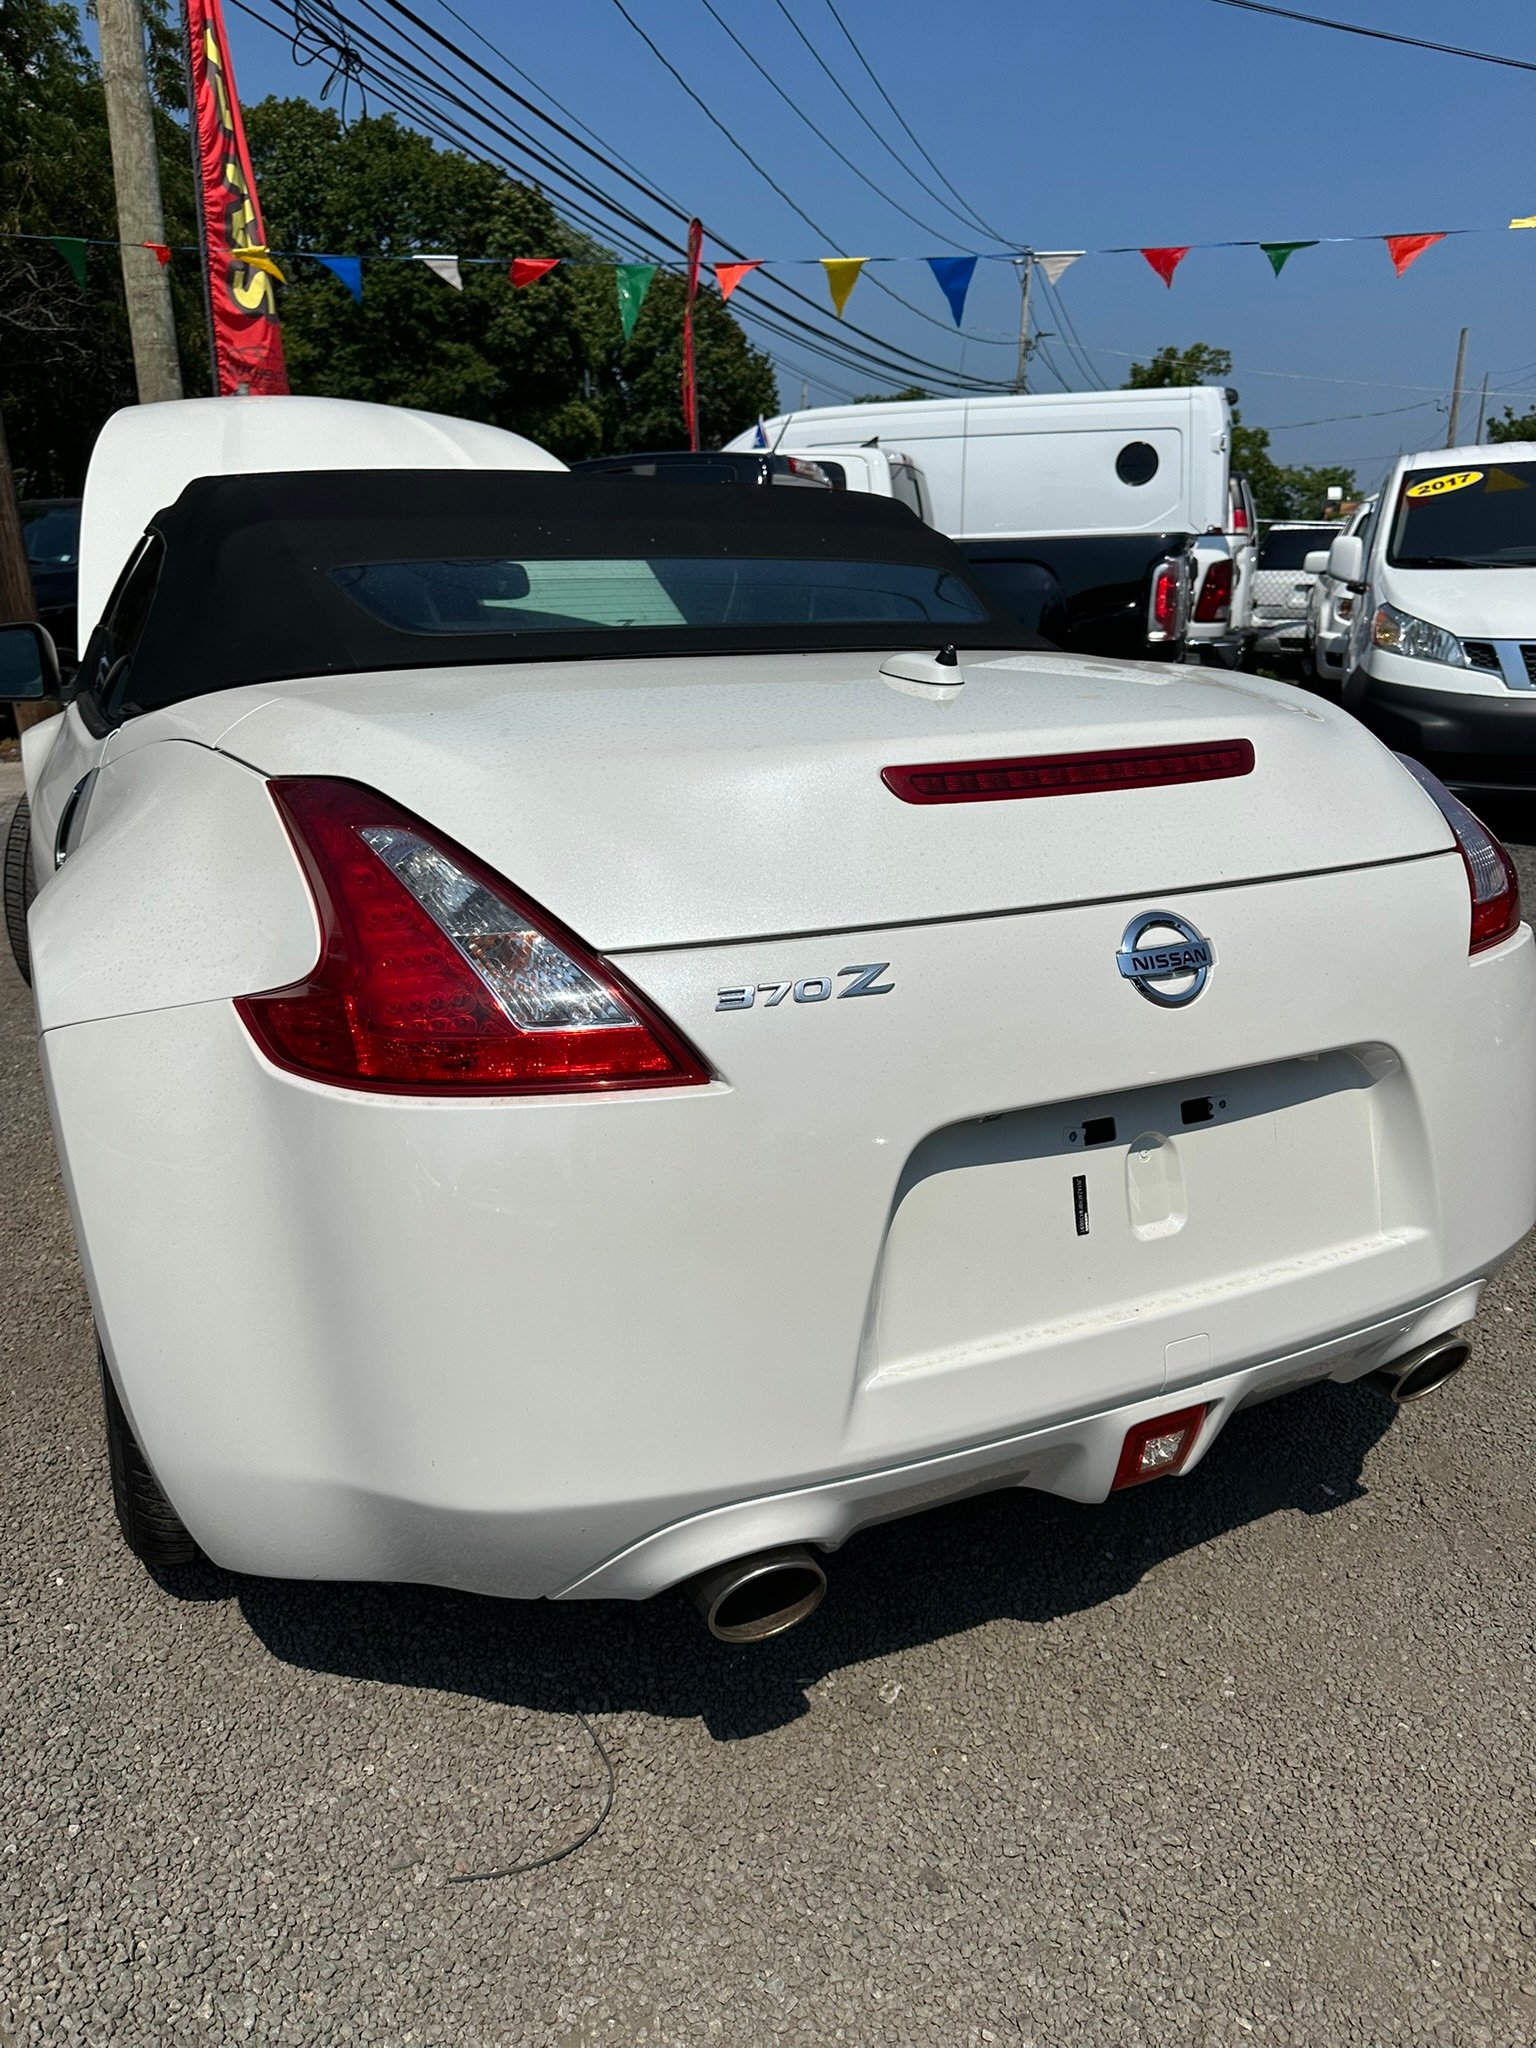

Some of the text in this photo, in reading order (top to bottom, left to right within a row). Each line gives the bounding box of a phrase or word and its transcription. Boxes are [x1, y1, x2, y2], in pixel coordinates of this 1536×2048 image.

[1418, 473, 1471, 495] 2017
[1131, 947, 1208, 972] NISSAN
[714, 962, 896, 1012] 370Z
